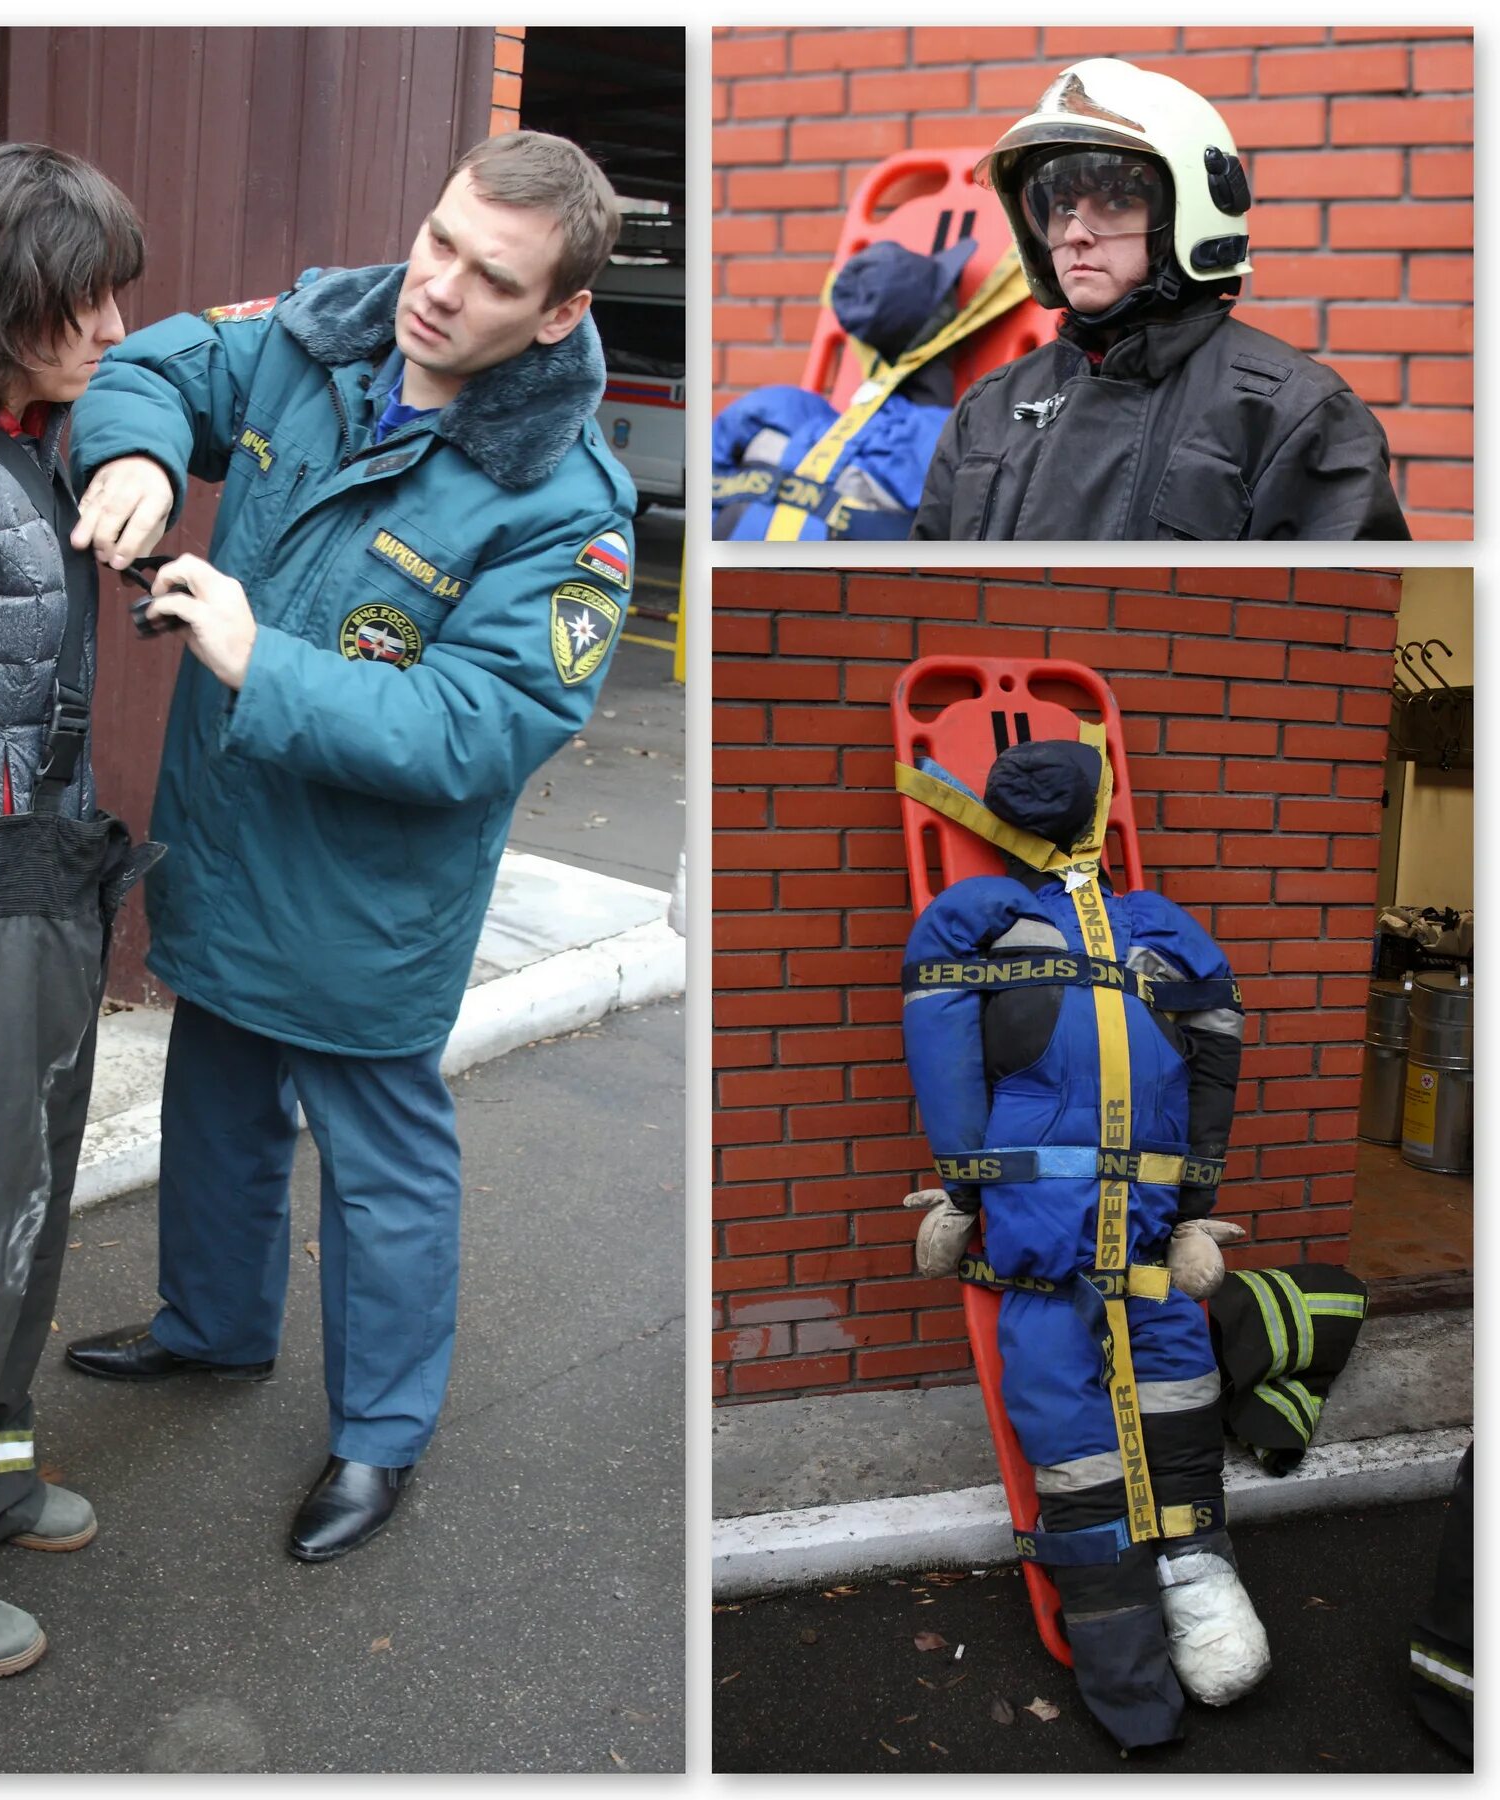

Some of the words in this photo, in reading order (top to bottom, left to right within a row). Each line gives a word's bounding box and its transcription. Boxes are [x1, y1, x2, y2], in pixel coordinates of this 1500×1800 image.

[372, 531, 437, 584] МАРКЕЛОВ
[352, 608, 378, 625] МЧС
[380, 608, 417, 649] РОССИИ
[919, 959, 1078, 984] SPENCER
